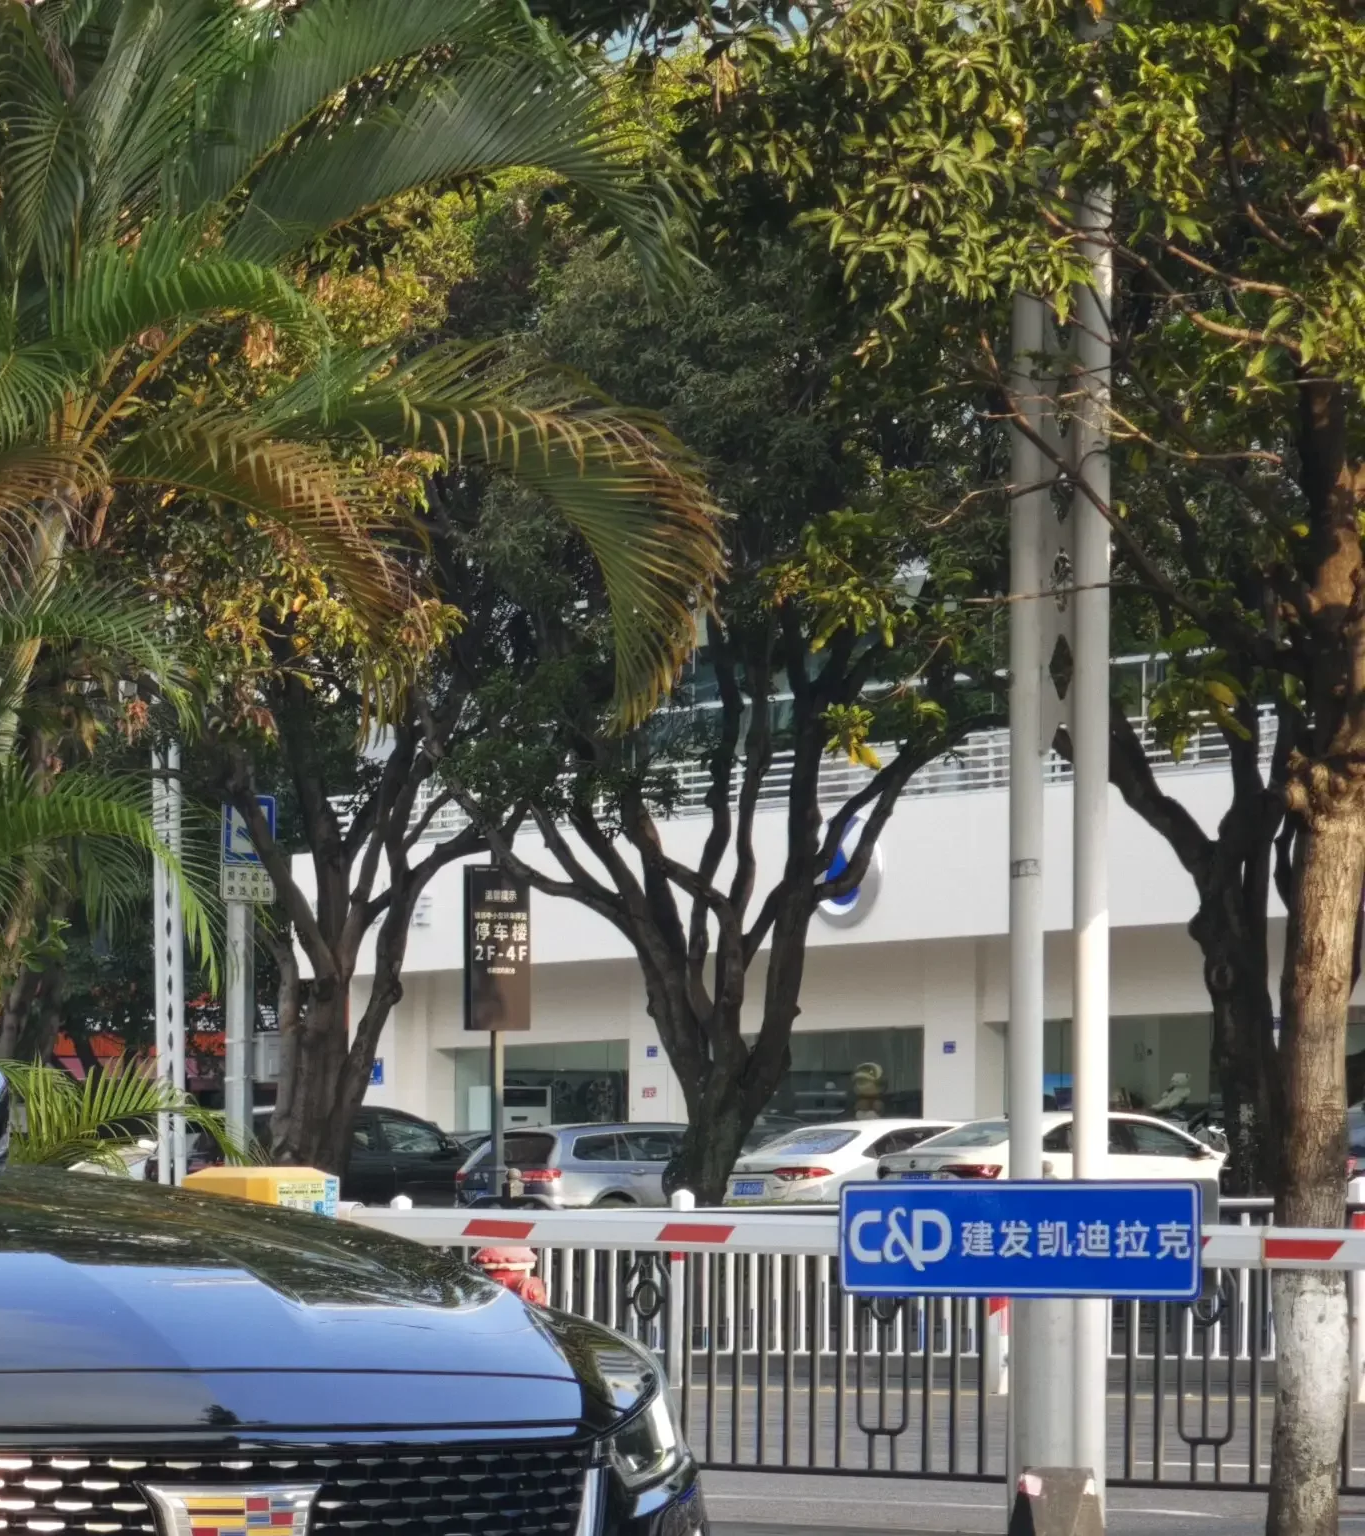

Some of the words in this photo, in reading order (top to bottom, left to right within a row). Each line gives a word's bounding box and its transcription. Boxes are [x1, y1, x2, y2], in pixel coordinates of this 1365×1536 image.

[475, 922, 528, 941] 停车楼
[475, 945, 528, 961] 2F-4F
[849, 1206, 953, 1271] C&D
[960, 1219, 1192, 1260] 建发凯迪拉克
